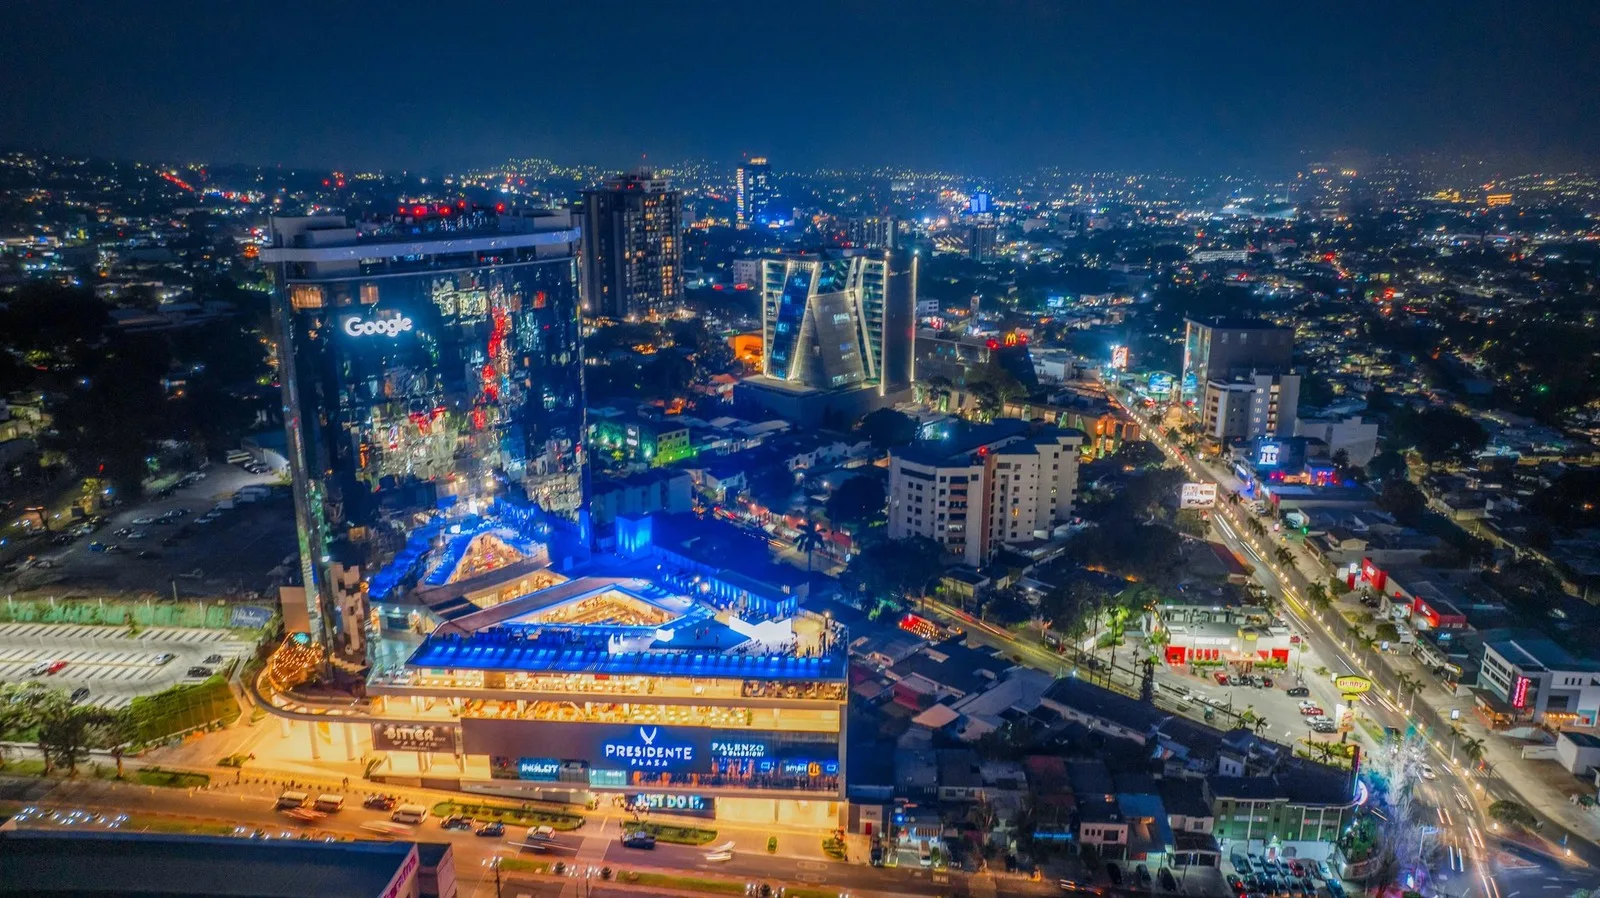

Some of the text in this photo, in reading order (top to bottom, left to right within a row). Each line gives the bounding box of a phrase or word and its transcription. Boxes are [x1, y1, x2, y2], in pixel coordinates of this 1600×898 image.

[345, 312, 413, 338] Google
[1339, 679, 1368, 690] Denny's
[383, 726, 434, 742] BITTER
[605, 744, 693, 760] PRESIDENTE
[712, 742, 764, 752] PALENZO
[631, 758, 668, 767] PLAZA
[635, 792, 665, 809] JUST
[666, 794, 687, 809] DO
